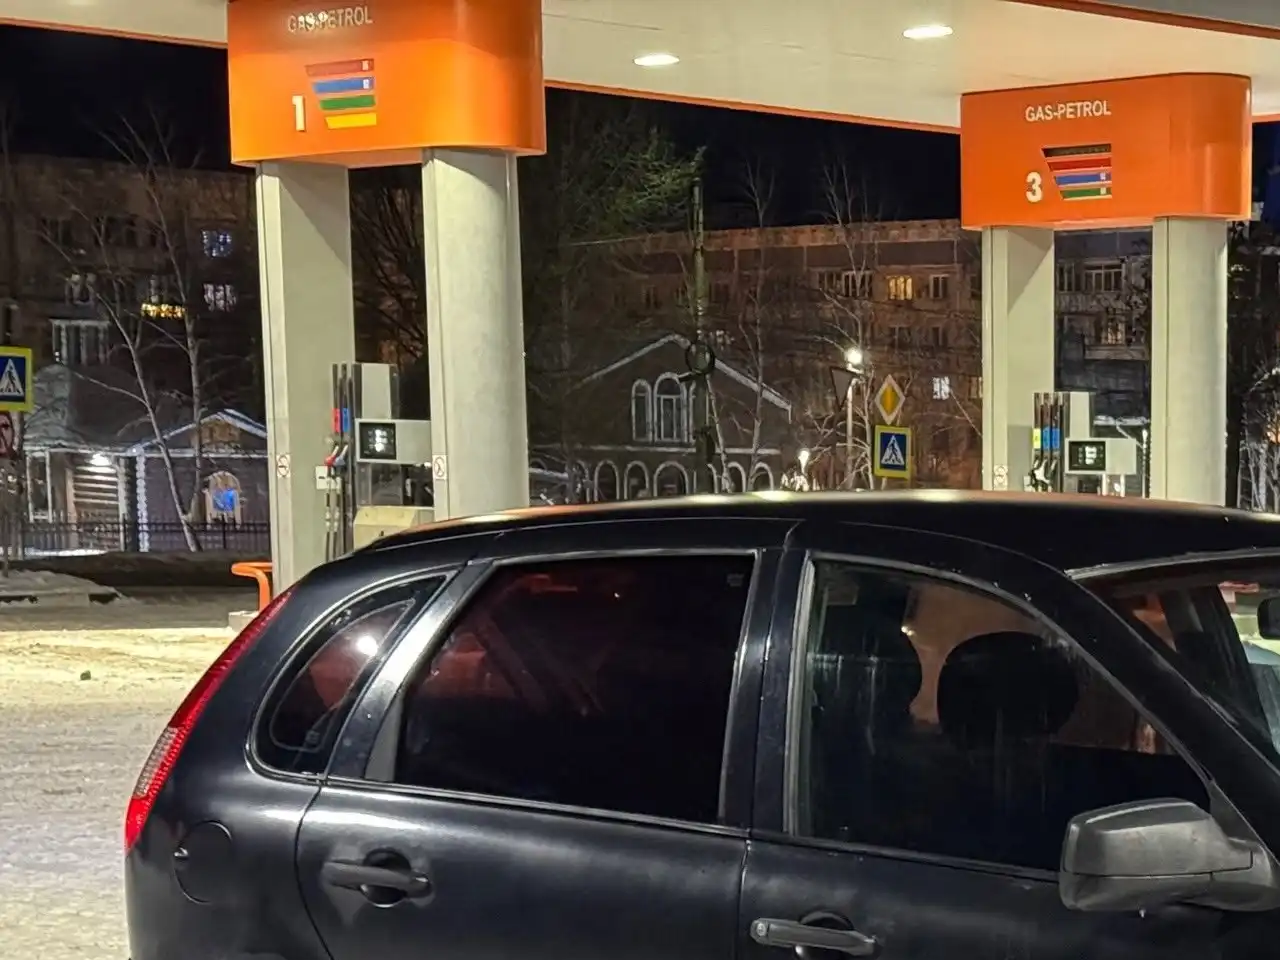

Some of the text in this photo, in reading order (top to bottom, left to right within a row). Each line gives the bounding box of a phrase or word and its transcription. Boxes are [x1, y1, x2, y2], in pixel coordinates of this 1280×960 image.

[287, 5, 373, 33] GAS-PETROL
[292, 95, 306, 131] 1
[1025, 100, 1112, 122] GAS-PETROL
[1026, 171, 1043, 203] 3
